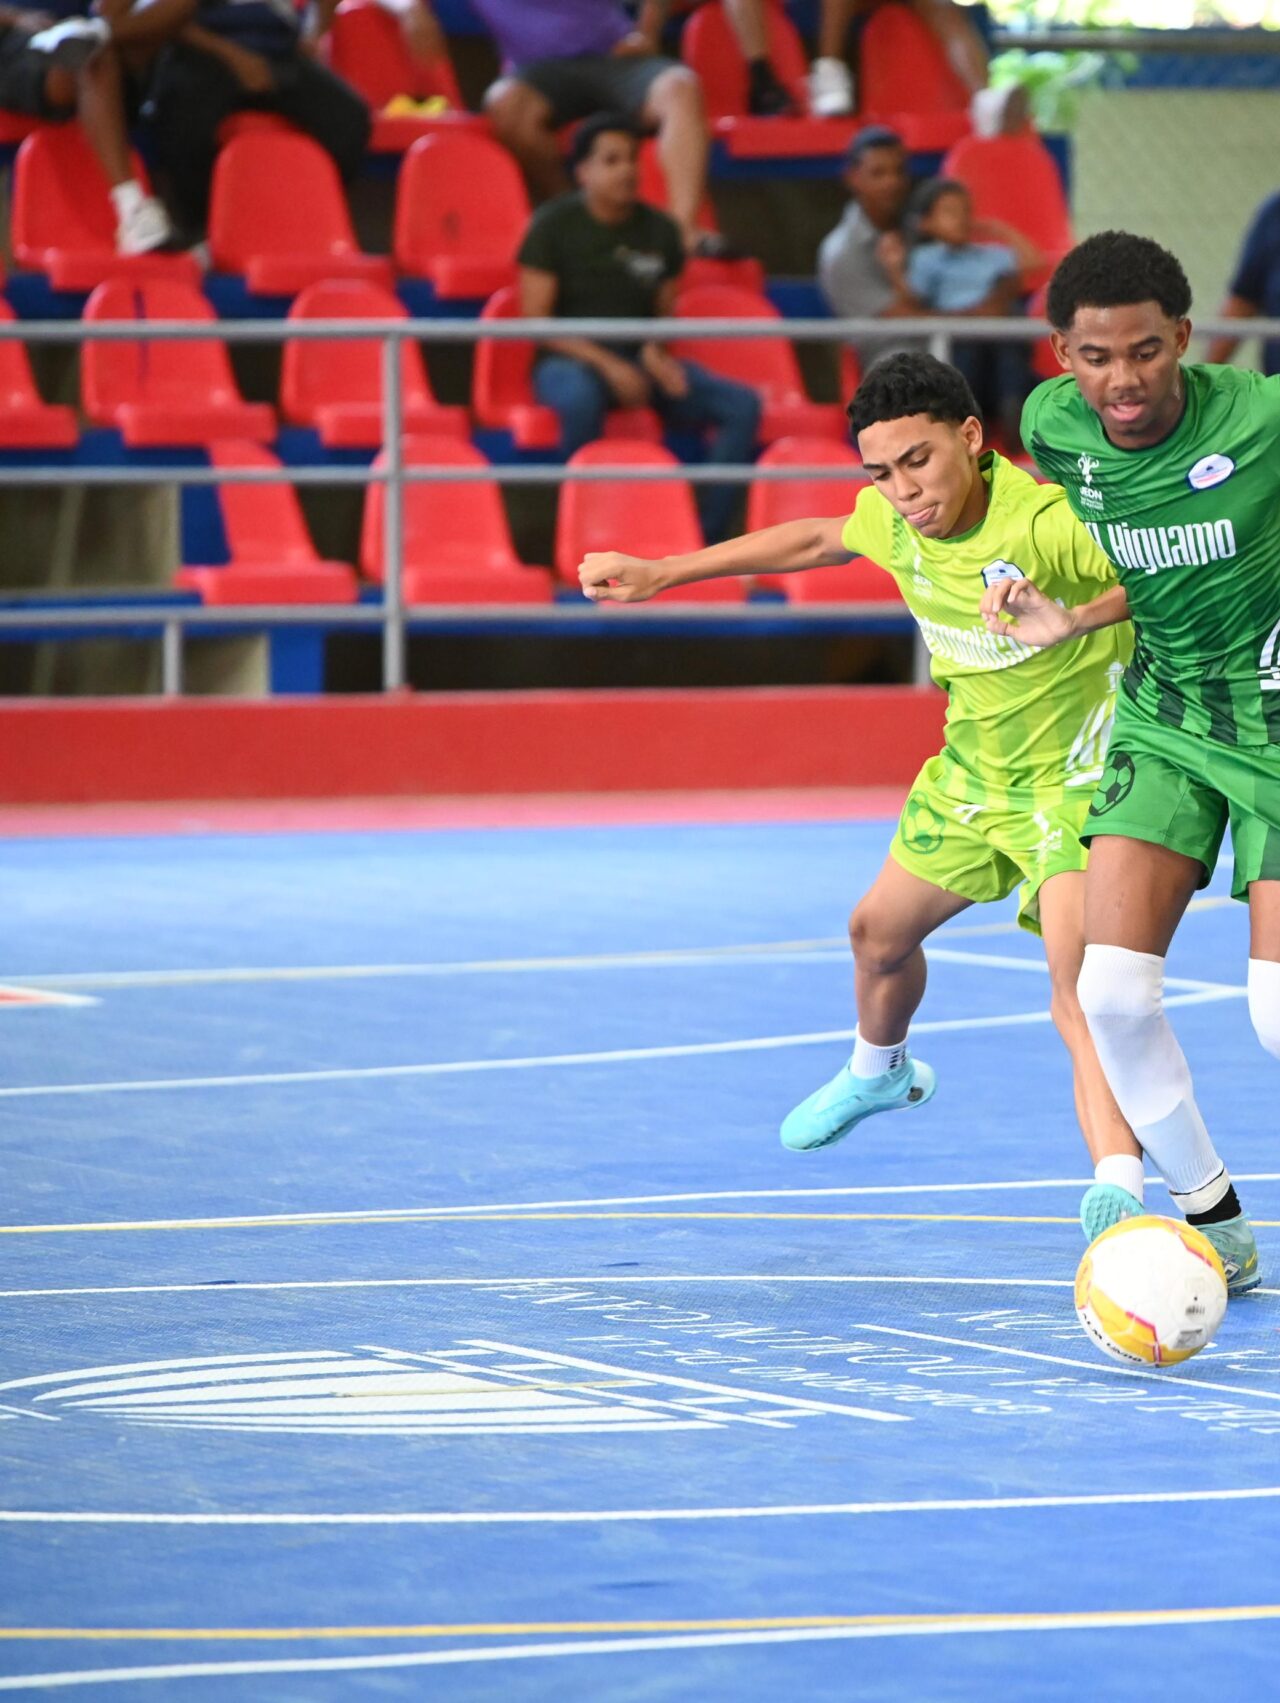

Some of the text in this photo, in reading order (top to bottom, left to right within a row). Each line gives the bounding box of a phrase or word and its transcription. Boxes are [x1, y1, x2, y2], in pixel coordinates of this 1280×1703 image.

[1107, 518, 1237, 575] Higuamo
[471, 1282, 1026, 1377] DOMINICANA
[636, 1348, 757, 1366] DE
[728, 1366, 1053, 1415] GOBIERNO
